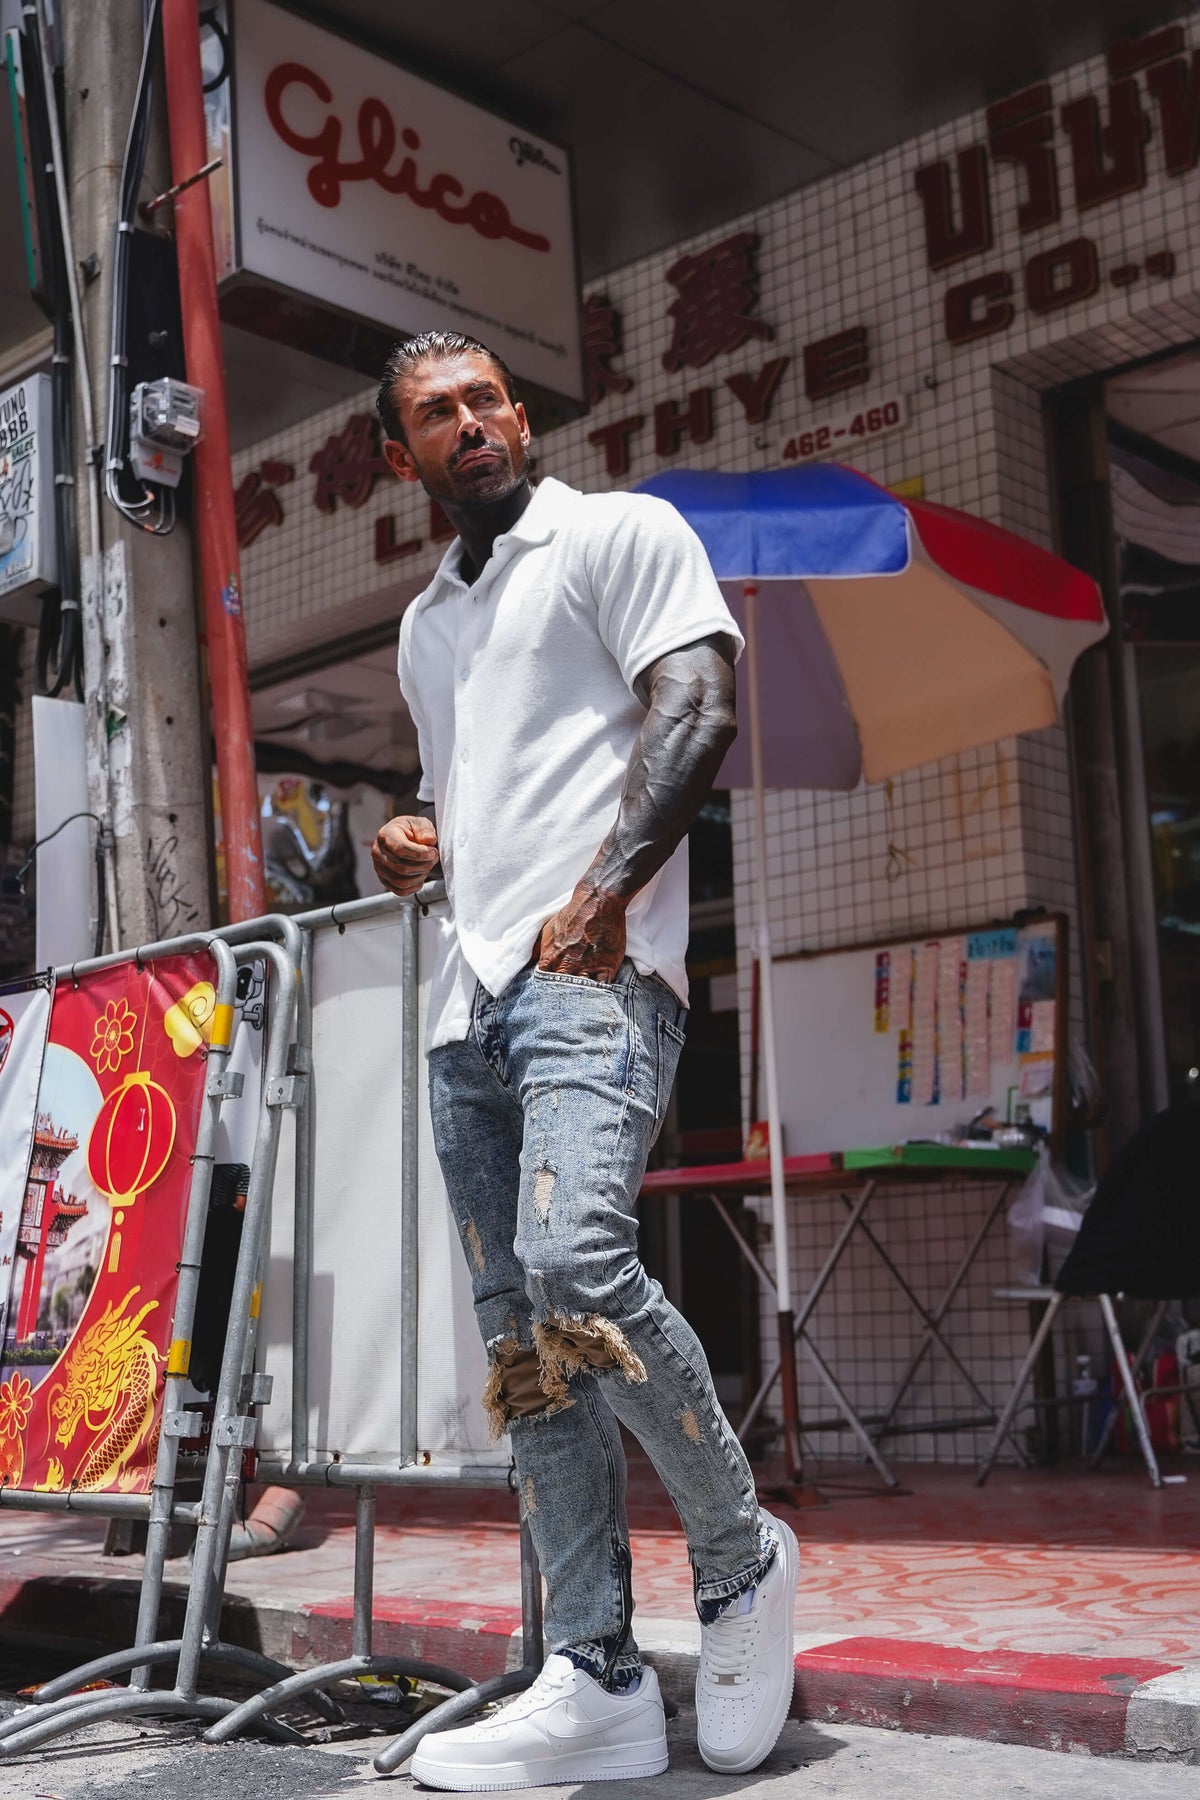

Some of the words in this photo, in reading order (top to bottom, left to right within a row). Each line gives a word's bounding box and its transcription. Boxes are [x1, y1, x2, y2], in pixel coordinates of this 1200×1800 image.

[264, 62, 551, 253] Glico
[588, 325, 870, 478] THYE
[782, 401, 898, 460] 462-460
